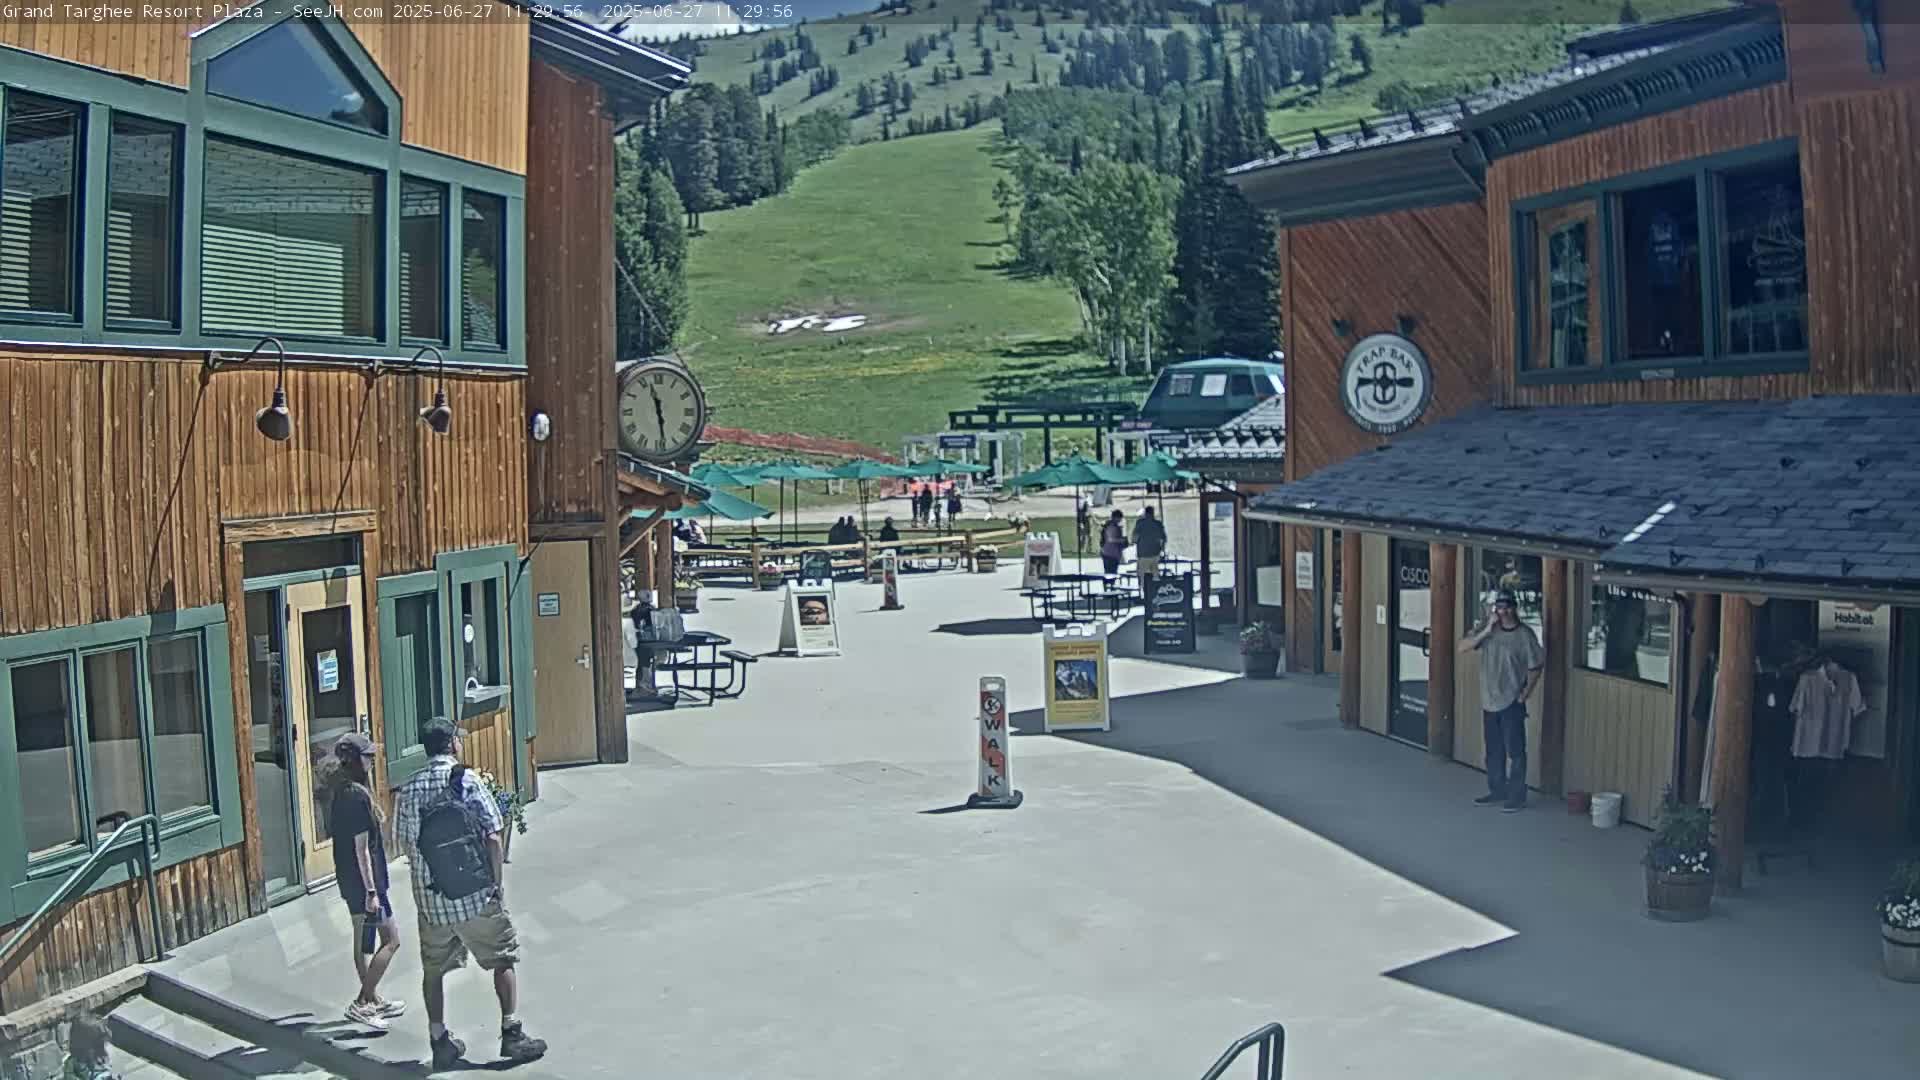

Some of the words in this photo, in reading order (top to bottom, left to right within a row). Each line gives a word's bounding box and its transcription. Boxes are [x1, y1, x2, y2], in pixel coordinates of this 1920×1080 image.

[1356, 346, 1386, 374] TRAP
[1390, 347, 1414, 373] BAR
[1400, 565, 1430, 584] CISCO
[1834, 611, 1874, 626] Habitat
[984, 719, 1001, 787] WALK
